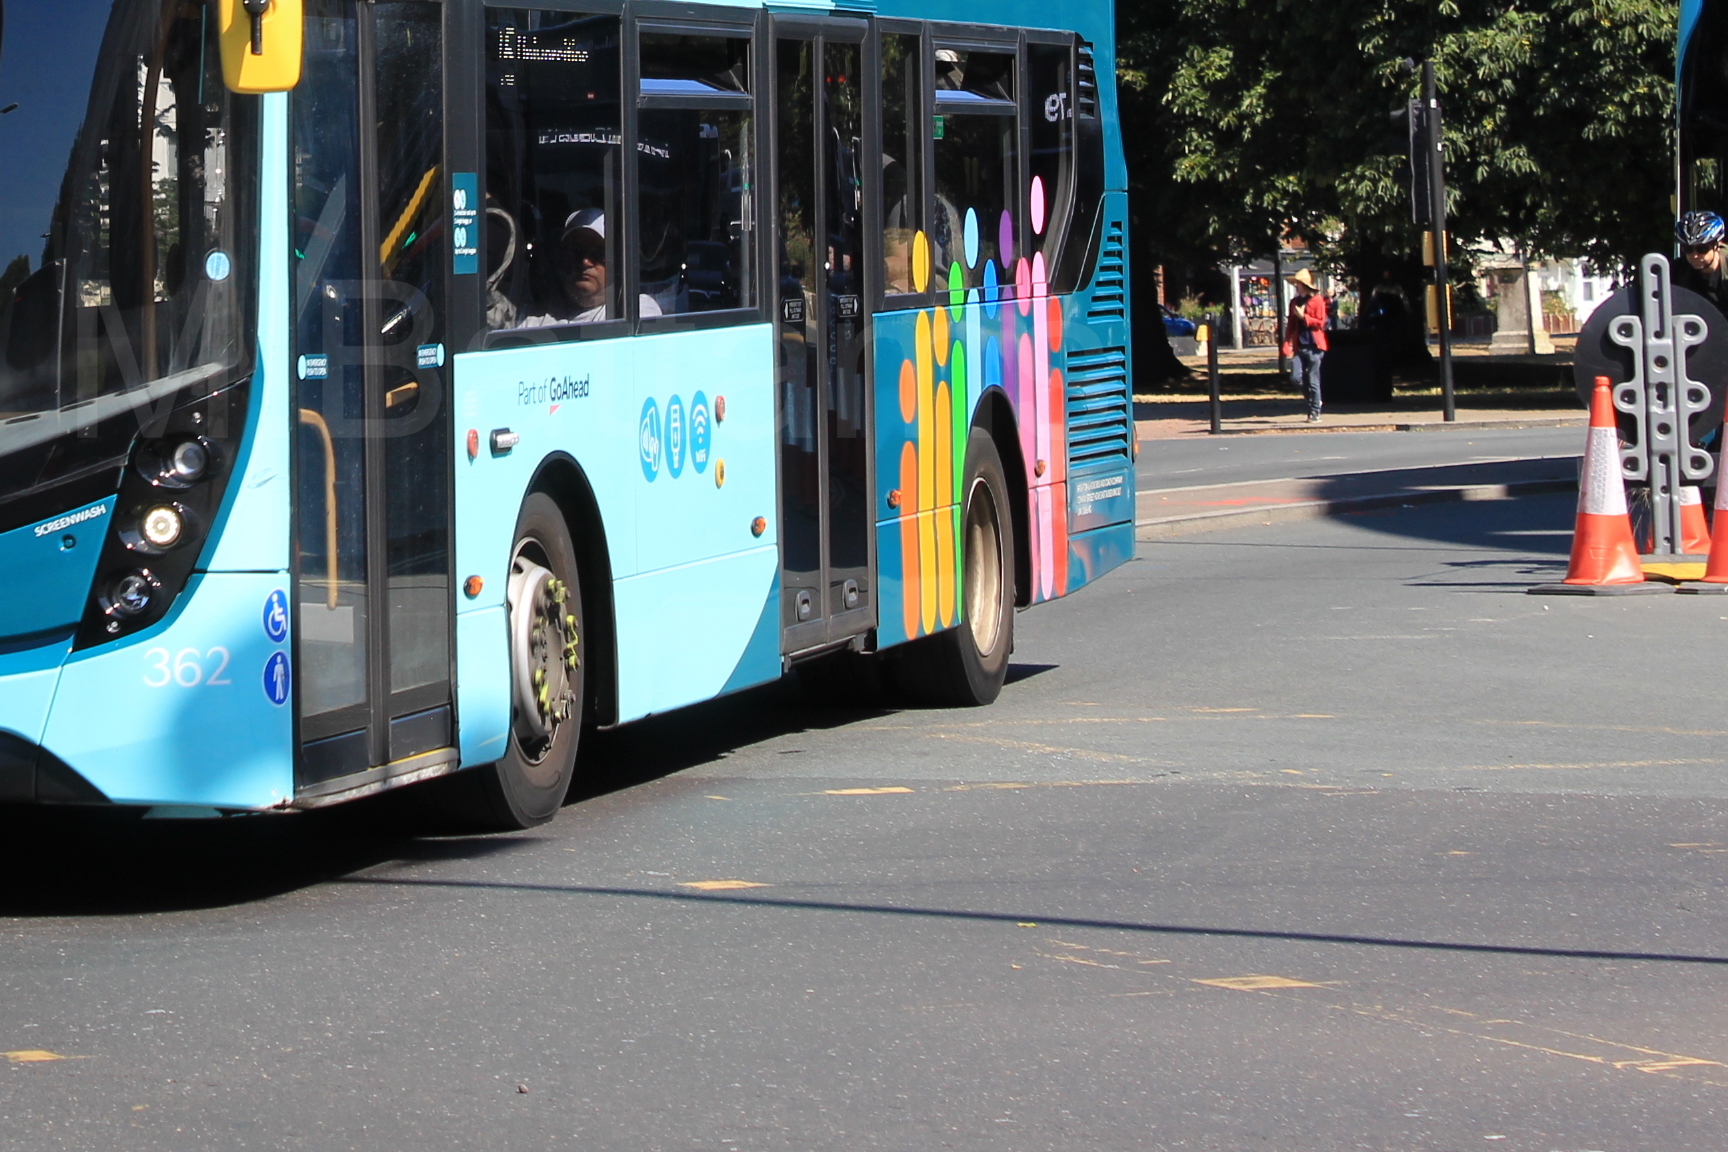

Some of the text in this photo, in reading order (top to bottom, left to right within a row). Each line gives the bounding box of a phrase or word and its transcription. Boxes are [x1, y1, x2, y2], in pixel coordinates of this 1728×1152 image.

[518, 373, 590, 406] Part of GoAhead
[34, 504, 107, 537] SCREENWASH
[142, 646, 232, 687] 362
